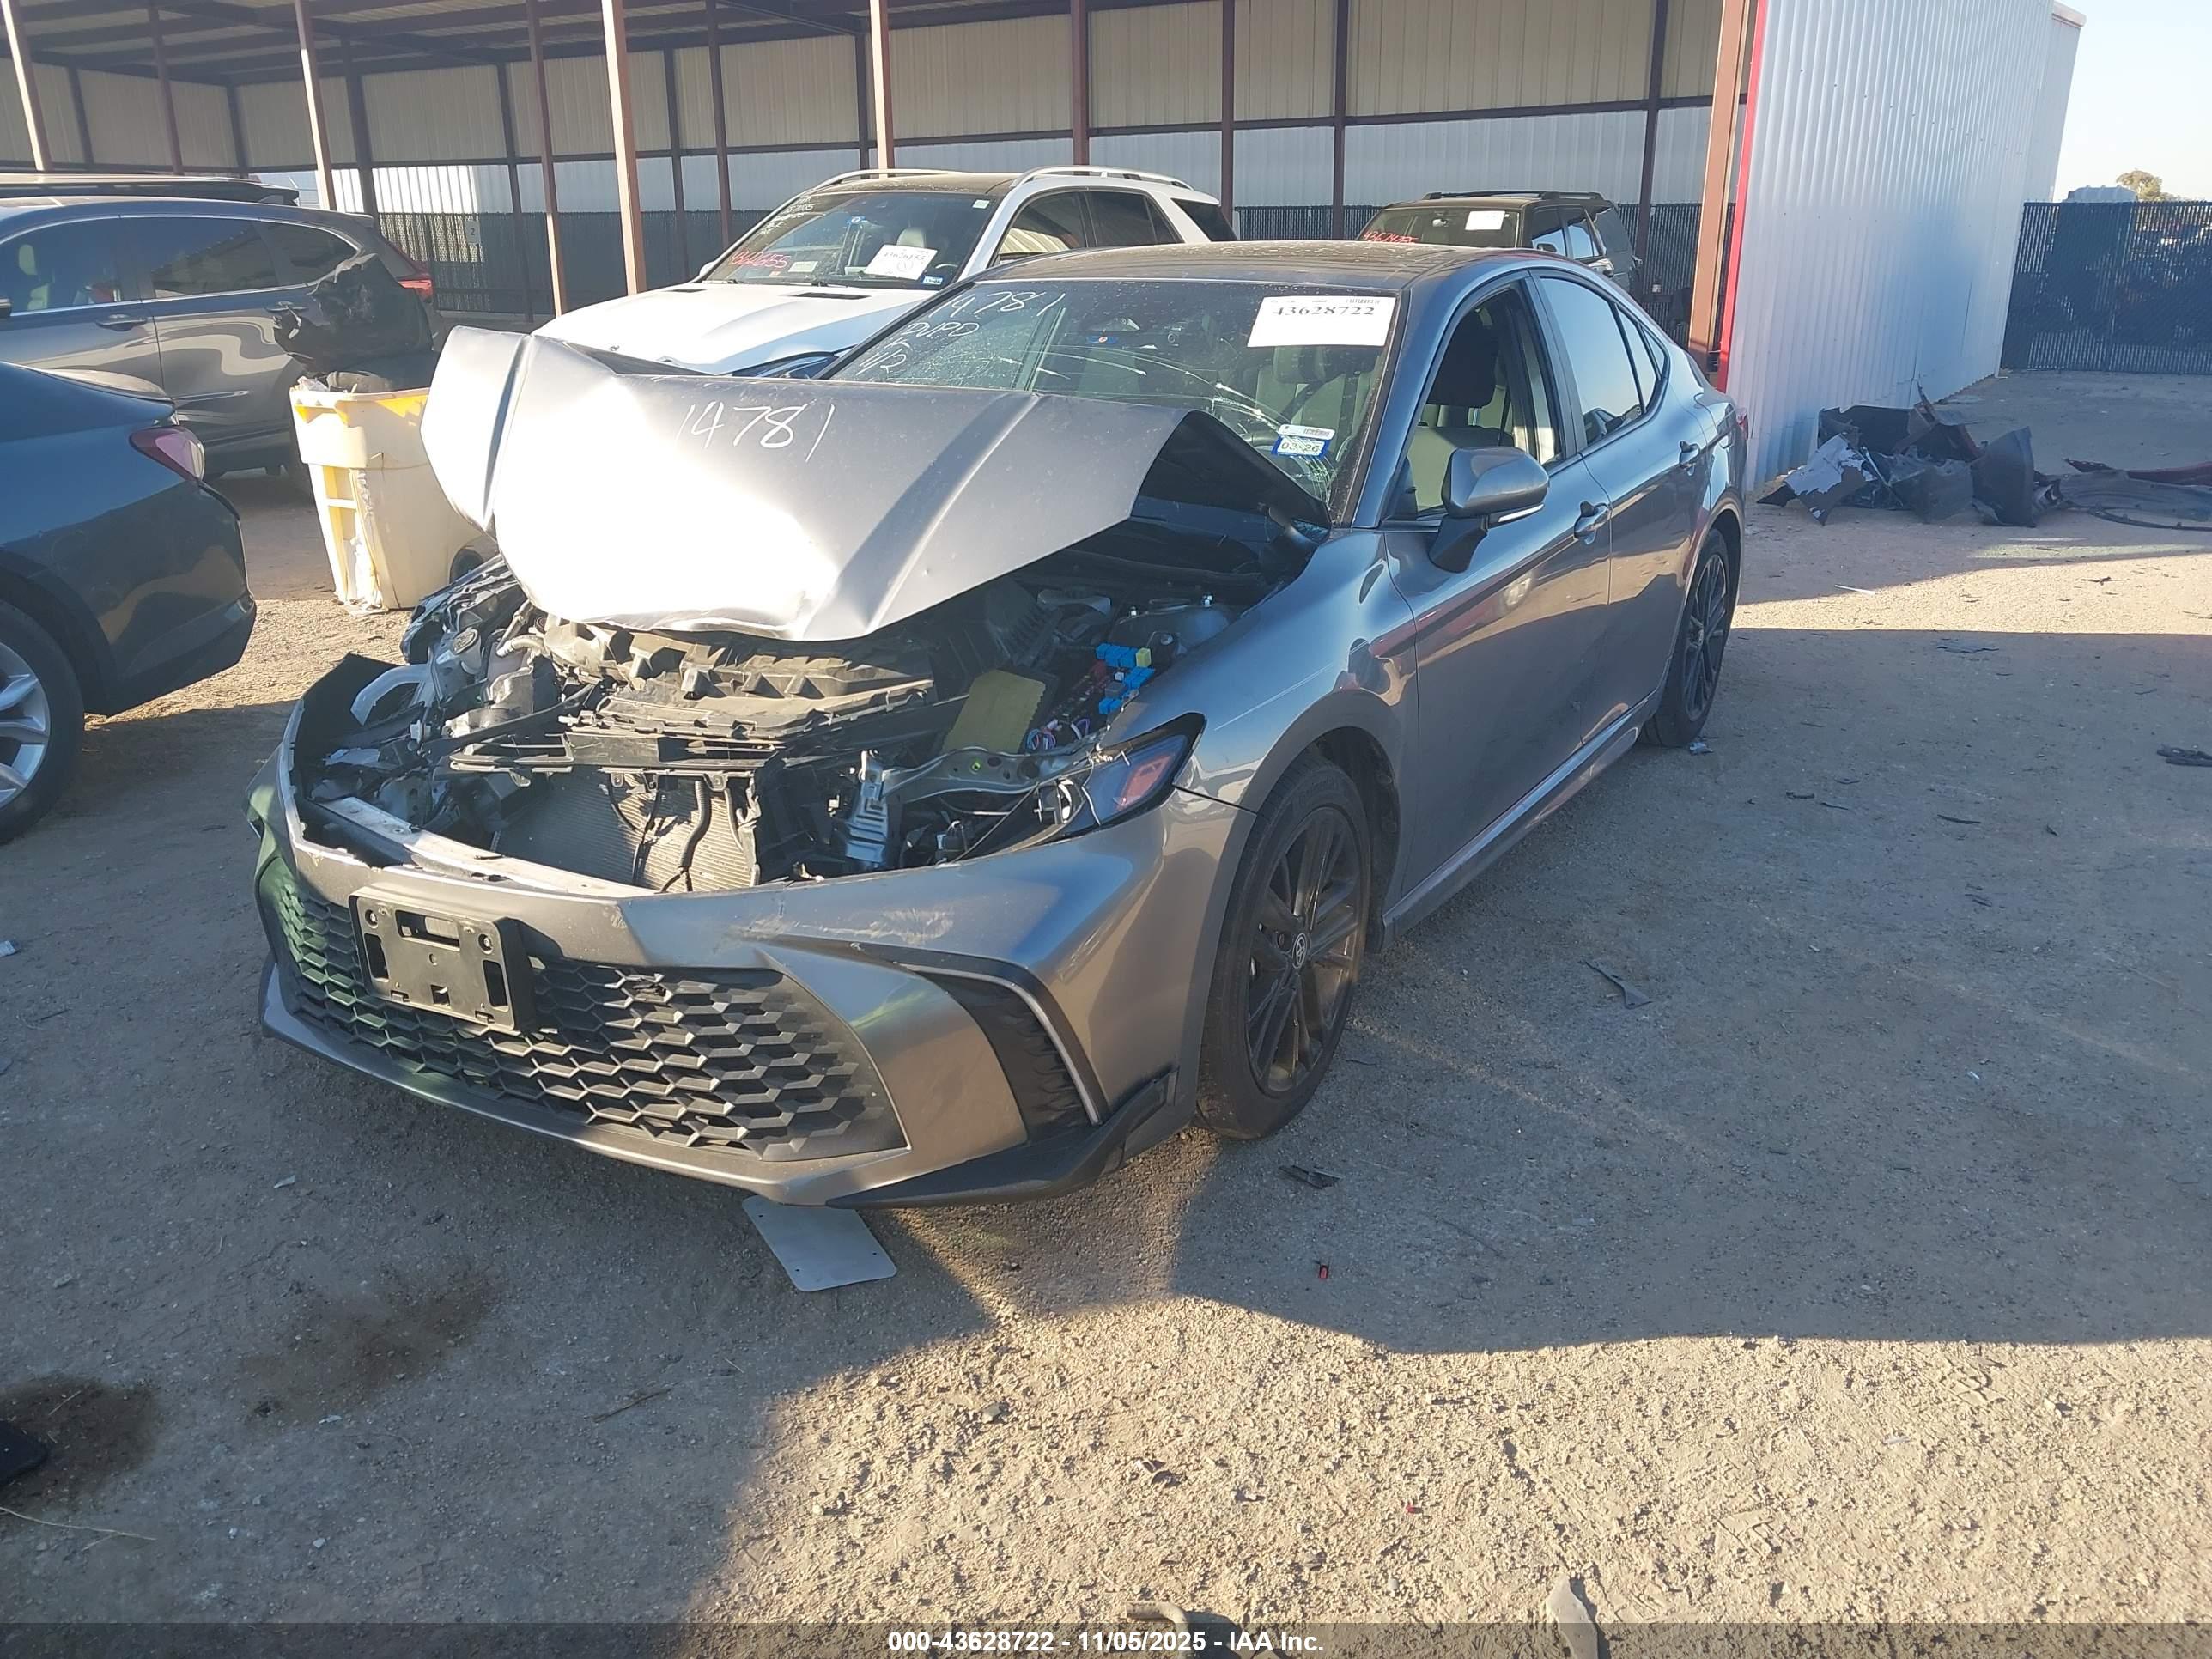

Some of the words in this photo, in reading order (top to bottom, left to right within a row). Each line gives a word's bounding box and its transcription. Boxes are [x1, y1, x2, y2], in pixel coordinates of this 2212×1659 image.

[928, 291, 1066, 319] 14781
[1270, 306, 1376, 316] 43628722
[675, 398, 836, 463] 14781
